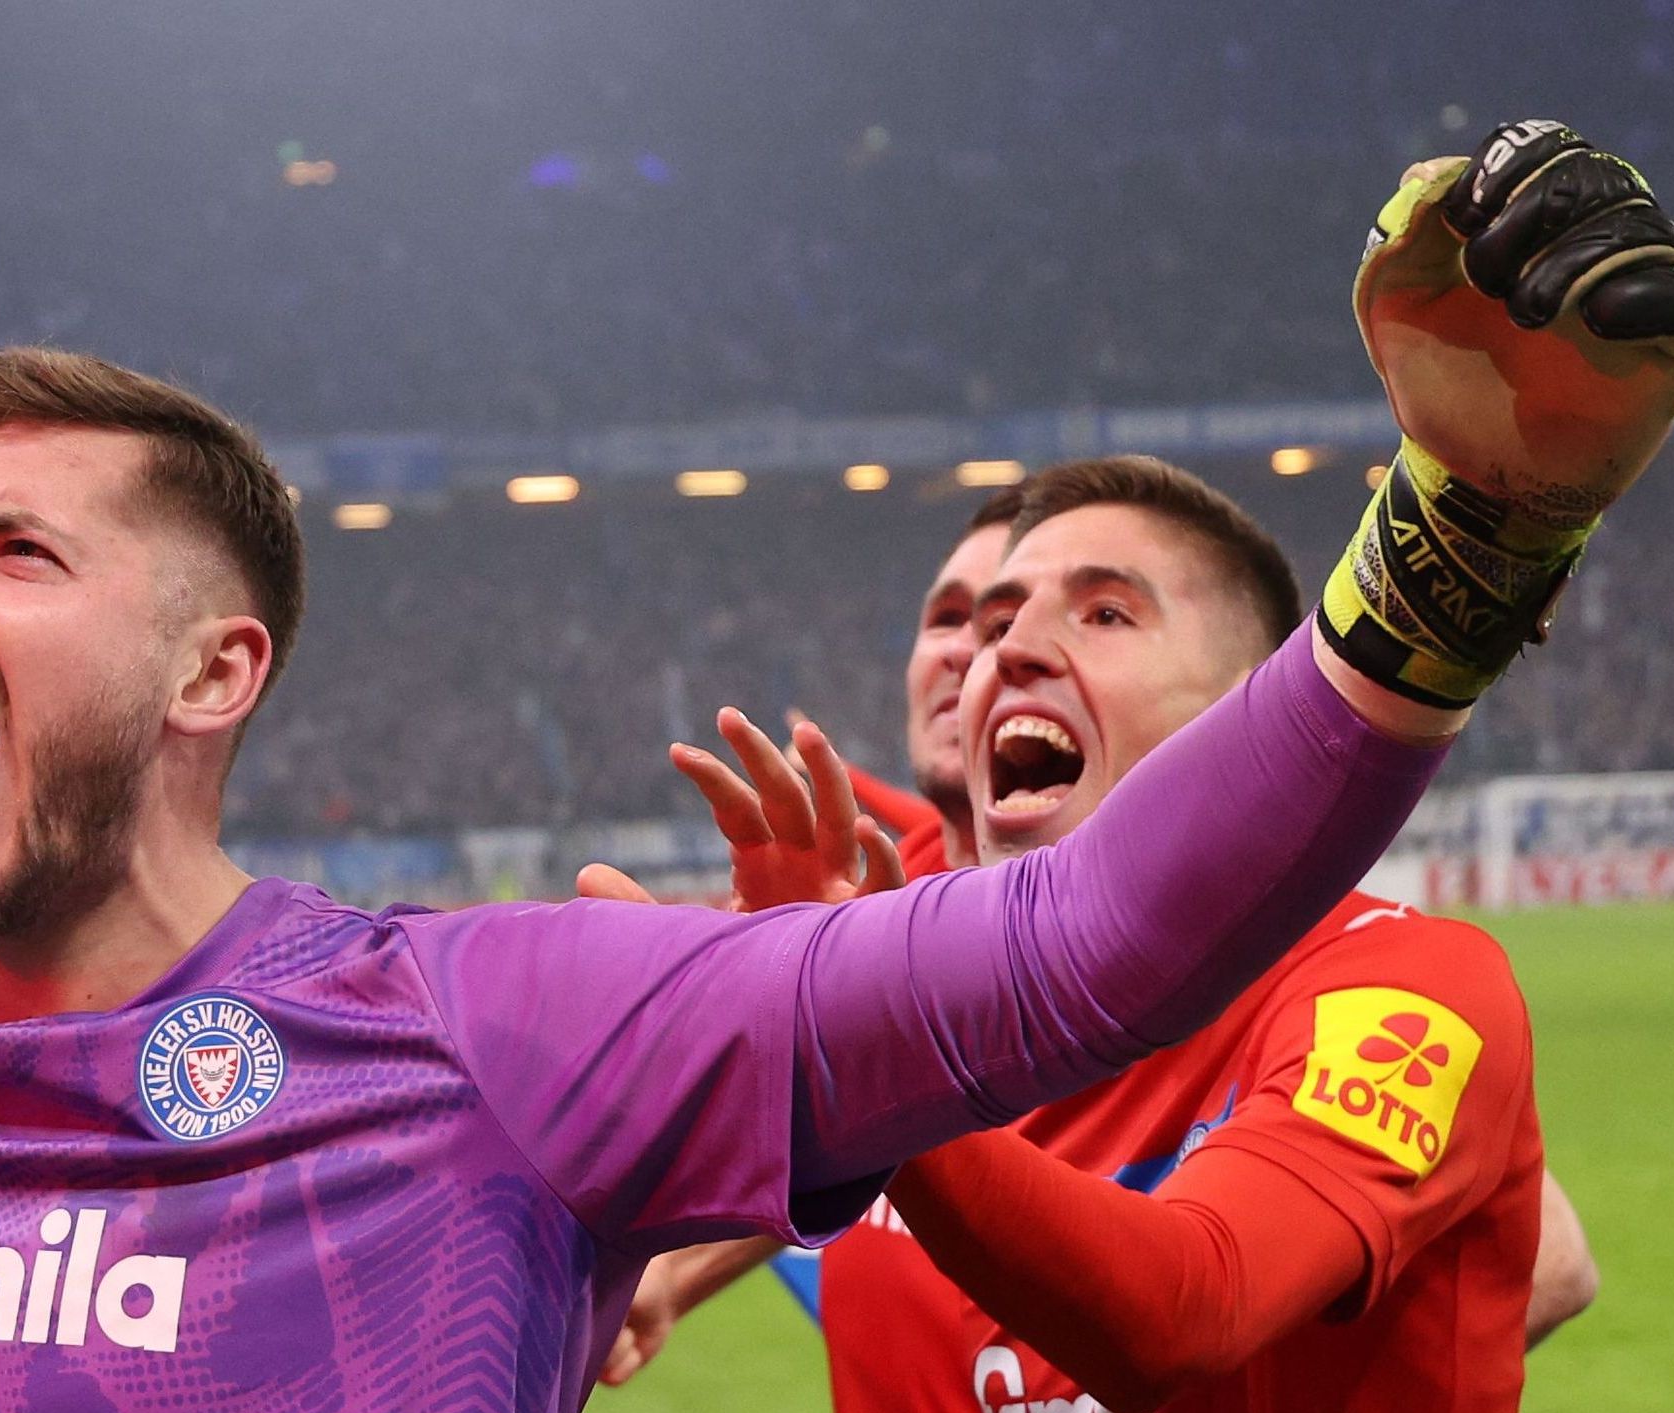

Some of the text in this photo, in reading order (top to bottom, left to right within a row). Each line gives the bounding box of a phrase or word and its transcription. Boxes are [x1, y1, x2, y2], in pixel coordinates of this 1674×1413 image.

[146, 1020, 188, 1101] KIELER
[216, 1004, 278, 1090] HOLSTEIN
[165, 1097, 258, 1136] VON 1900
[1310, 1067, 1441, 1164] LOTTO
